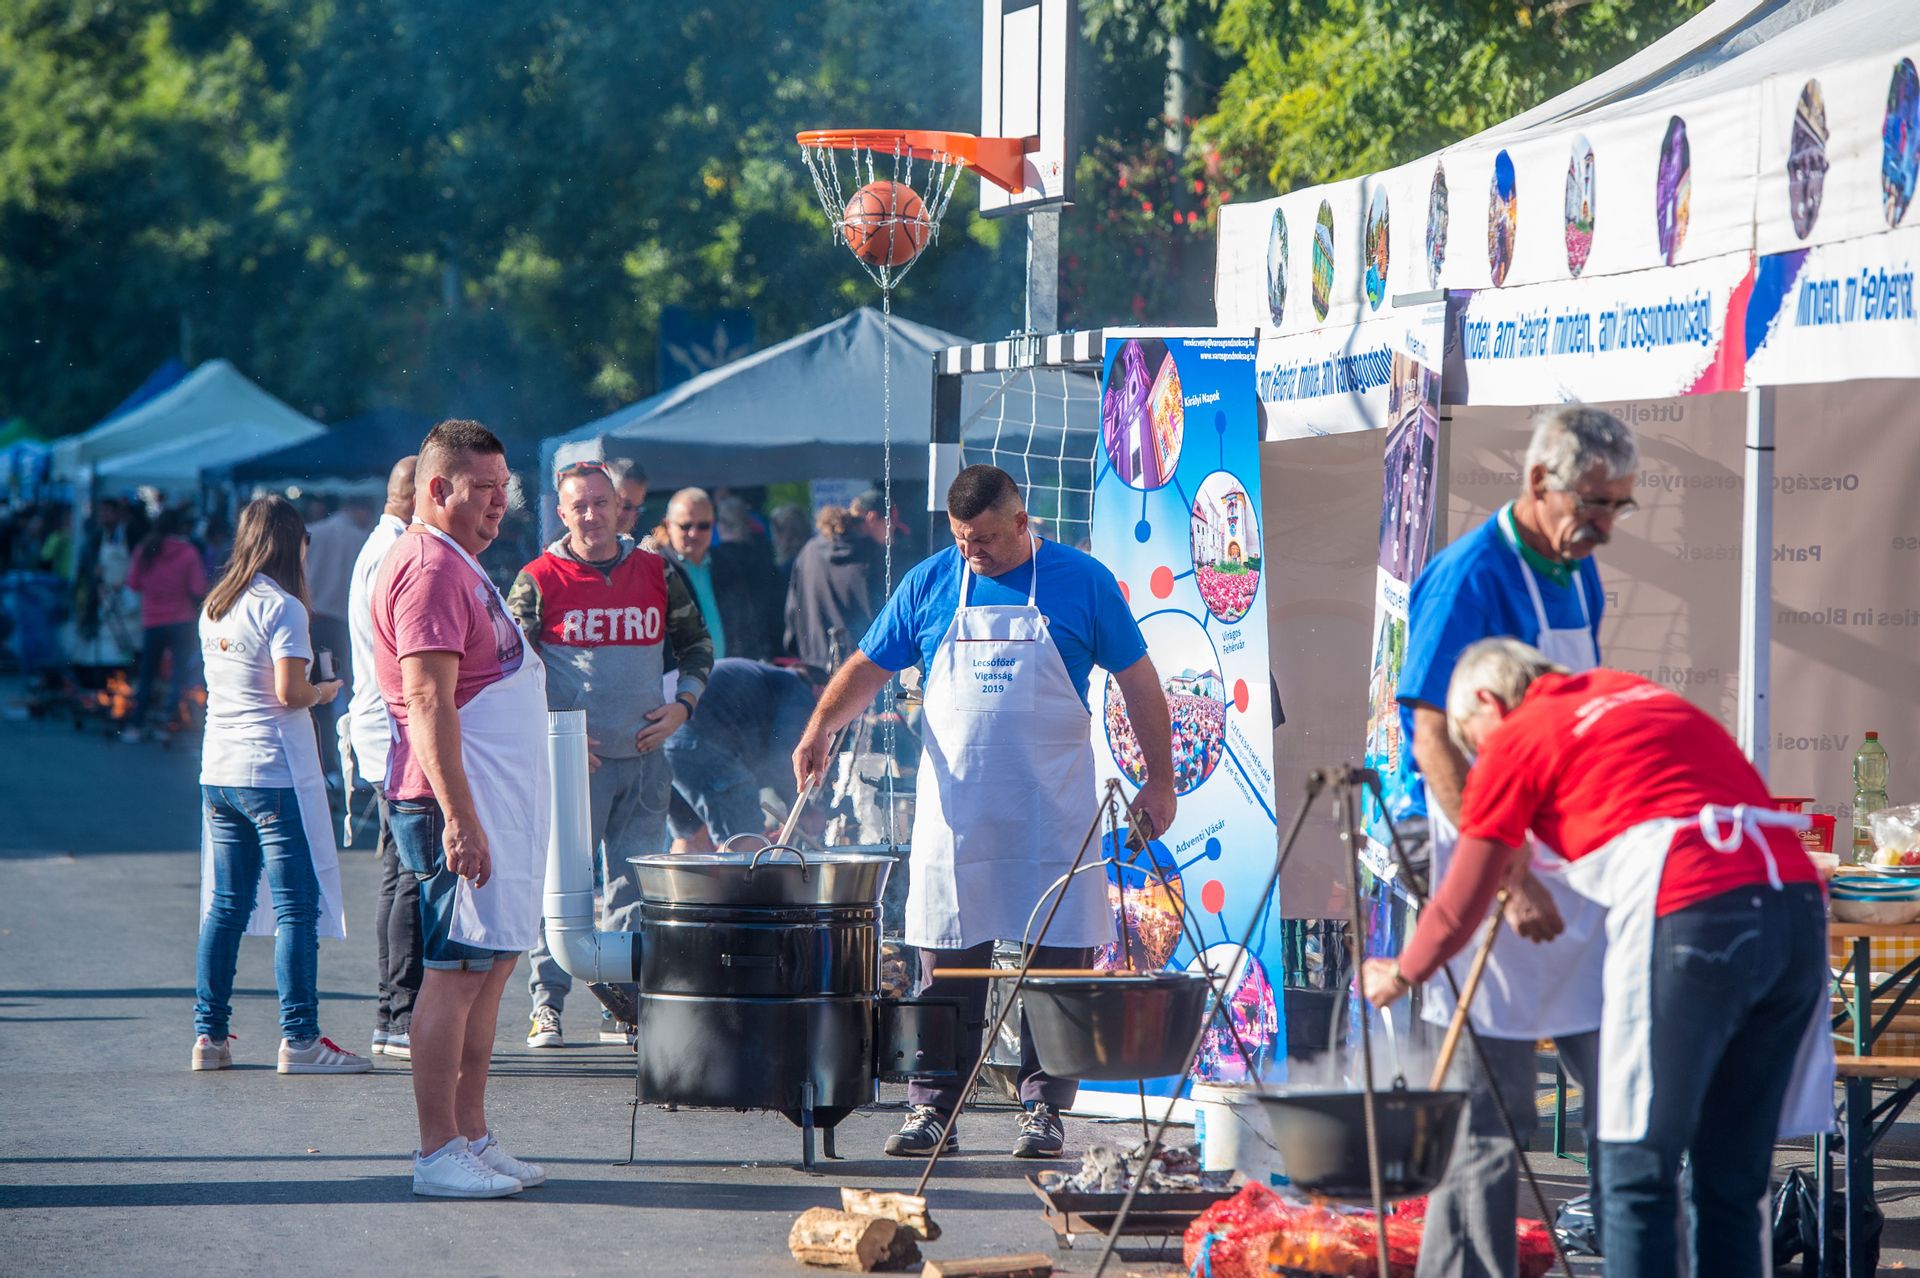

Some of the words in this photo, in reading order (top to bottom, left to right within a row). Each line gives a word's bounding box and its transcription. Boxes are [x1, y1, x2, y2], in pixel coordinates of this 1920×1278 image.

[562, 606, 660, 642] RETRO
[973, 657, 1016, 668] Lecsófőző
[975, 671, 1013, 682] Vigasság
[982, 685, 1004, 694] 2019
[1176, 830, 1206, 855] Adventi
[1205, 818, 1225, 836] Vásár
